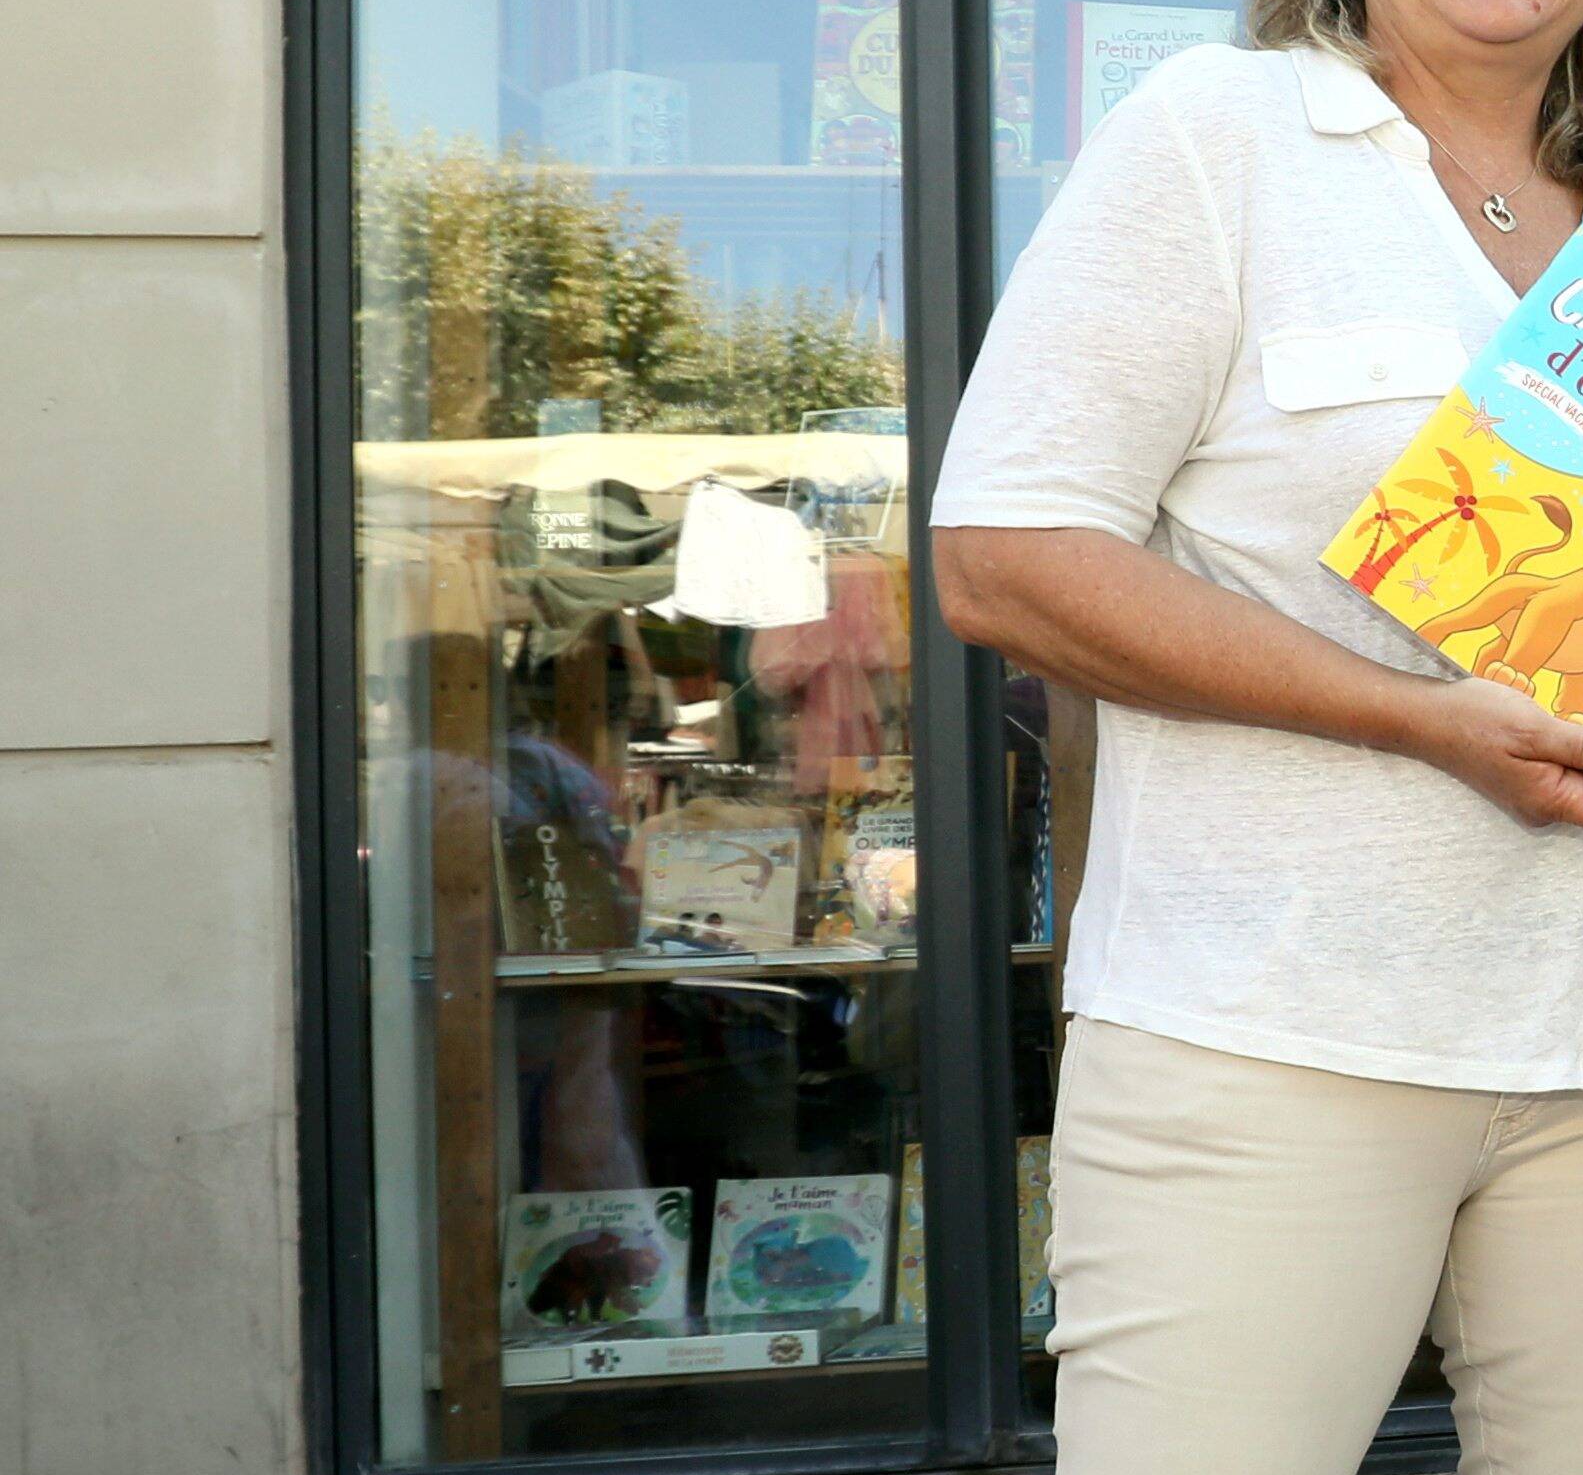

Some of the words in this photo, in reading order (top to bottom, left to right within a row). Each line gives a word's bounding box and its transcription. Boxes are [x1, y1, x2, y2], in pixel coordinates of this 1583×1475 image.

[1125, 29, 1167, 42] Grand
[1171, 29, 1205, 42] Livre
[1096, 40, 1142, 60] Petit
[1521, 373, 1564, 409] SPÉCIAL
